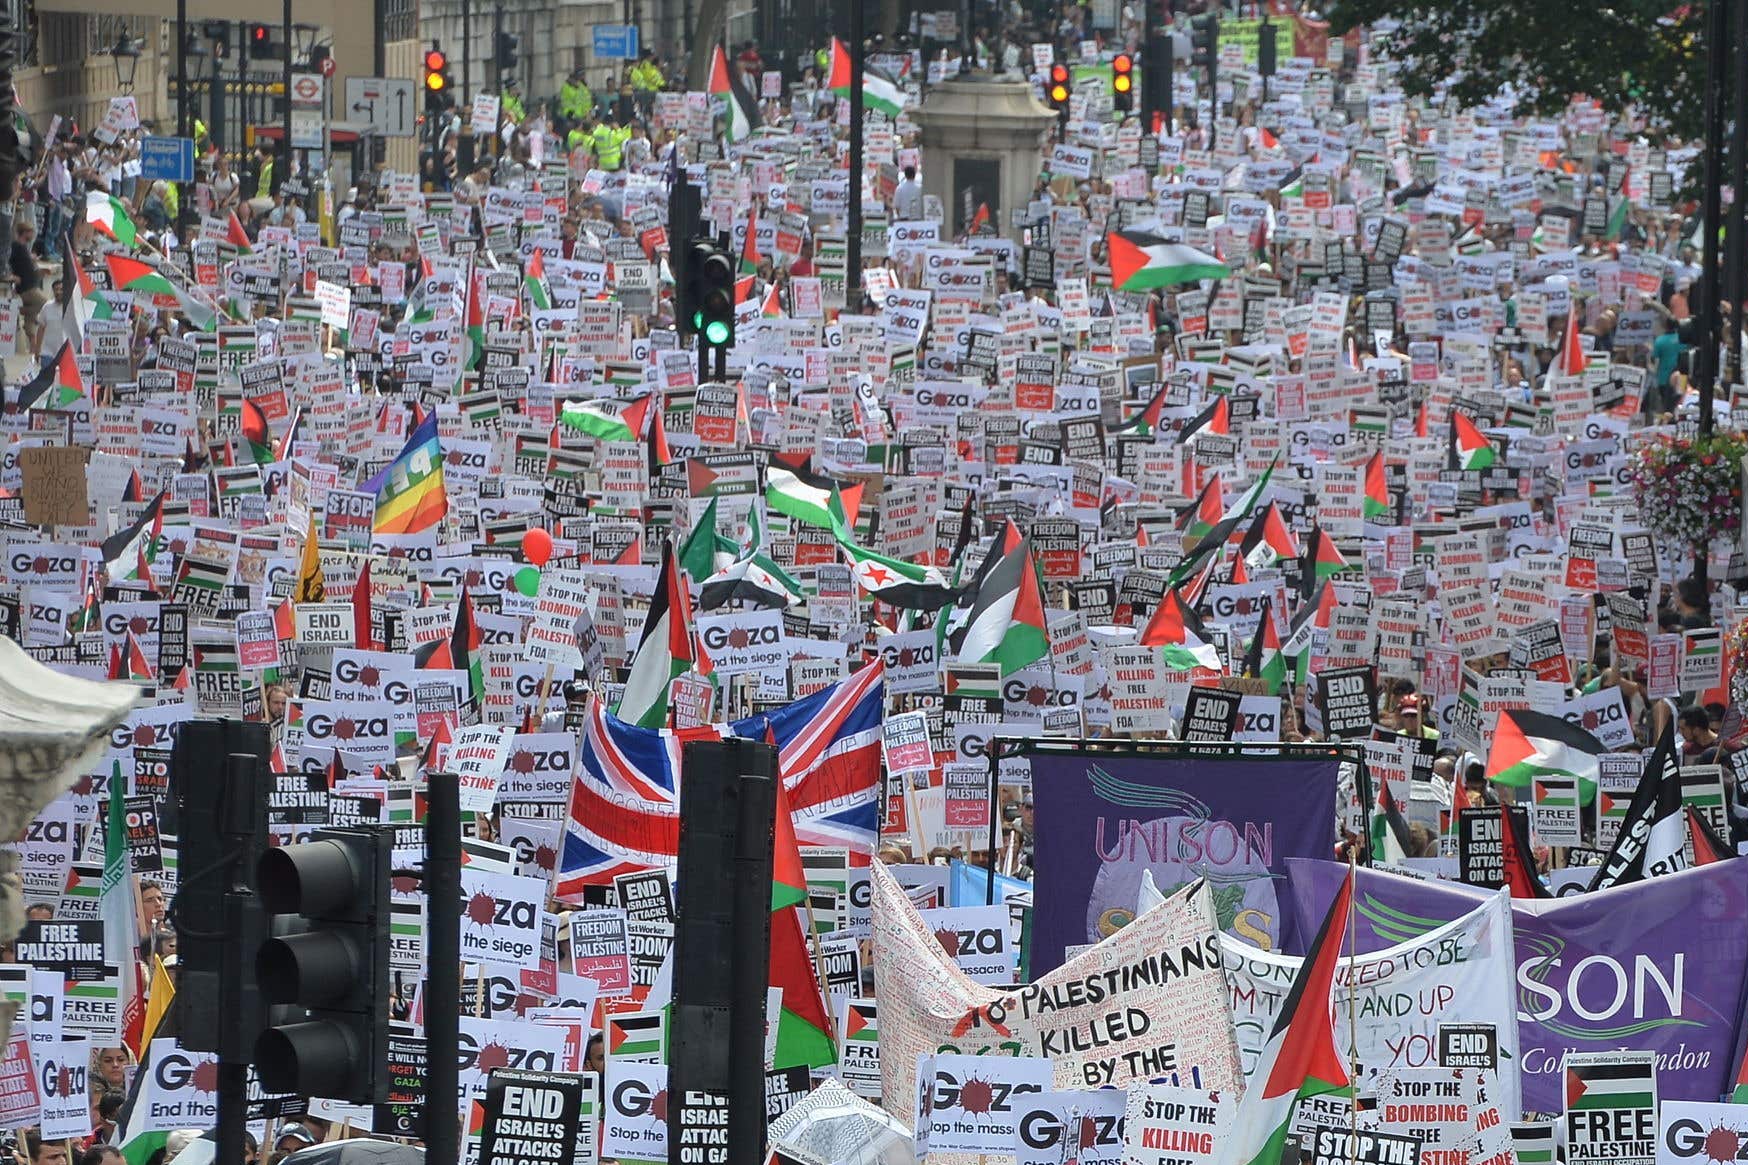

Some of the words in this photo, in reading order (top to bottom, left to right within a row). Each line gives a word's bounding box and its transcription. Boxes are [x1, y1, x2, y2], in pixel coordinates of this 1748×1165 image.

[623, 269, 642, 278] END
[697, 407, 735, 417] PALESTINE
[1067, 423, 1096, 438] END
[1025, 447, 1054, 462] END
[1034, 524, 1076, 535] FREEDOM
[1078, 589, 1107, 604] END
[309, 614, 340, 628] END
[550, 618, 570, 629] FREE
[302, 630, 349, 642] ISRAELI
[753, 652, 782, 664] siege
[1115, 655, 1132, 663] STOP
[1135, 656, 1153, 664] THE
[1685, 656, 1718, 668] FREE
[1116, 670, 1155, 680] KILLING
[1329, 681, 1363, 698] END
[1113, 697, 1164, 710] PALESTINE
[1328, 697, 1369, 709] ISRAEL'S
[946, 711, 999, 724] PALESTINE
[1327, 708, 1370, 718] ATTACKS
[1348, 716, 1373, 726] GAZA
[346, 743, 390, 753] massacre
[1602, 762, 1639, 773] FREEDOM
[948, 772, 986, 785] FREEDOM
[946, 788, 987, 799] PALESTINE
[1538, 810, 1575, 819] FREE
[1538, 819, 1575, 827] PALESTINE
[1094, 819, 1274, 867] UNISON
[40, 923, 77, 942] FREE
[464, 934, 486, 949] the
[491, 938, 533, 956] siege
[1397, 949, 1435, 970] TO
[1437, 933, 1468, 966] BE
[17, 943, 101, 962] PALESTINE
[1022, 936, 1223, 1021] PALESTINIANS
[1419, 986, 1454, 1014] UP
[63, 1001, 115, 1013] FREE
[62, 1013, 115, 1022] PALESTINE
[1040, 1005, 1151, 1056] KILLED
[1449, 1033, 1488, 1053] END
[1081, 1059, 1117, 1087] BY
[1124, 1045, 1178, 1075] THE
[1446, 1055, 1491, 1066] ISRAEL'S
[503, 1088, 563, 1118] END
[1386, 1103, 1468, 1122] BOMBING
[495, 1119, 564, 1140] ISRAEL'S
[1567, 1109, 1655, 1143] FREE
[492, 1138, 563, 1158] ATTACKS
[1142, 1132, 1213, 1154] KILLING
[1569, 1142, 1655, 1159] PALESTINE
